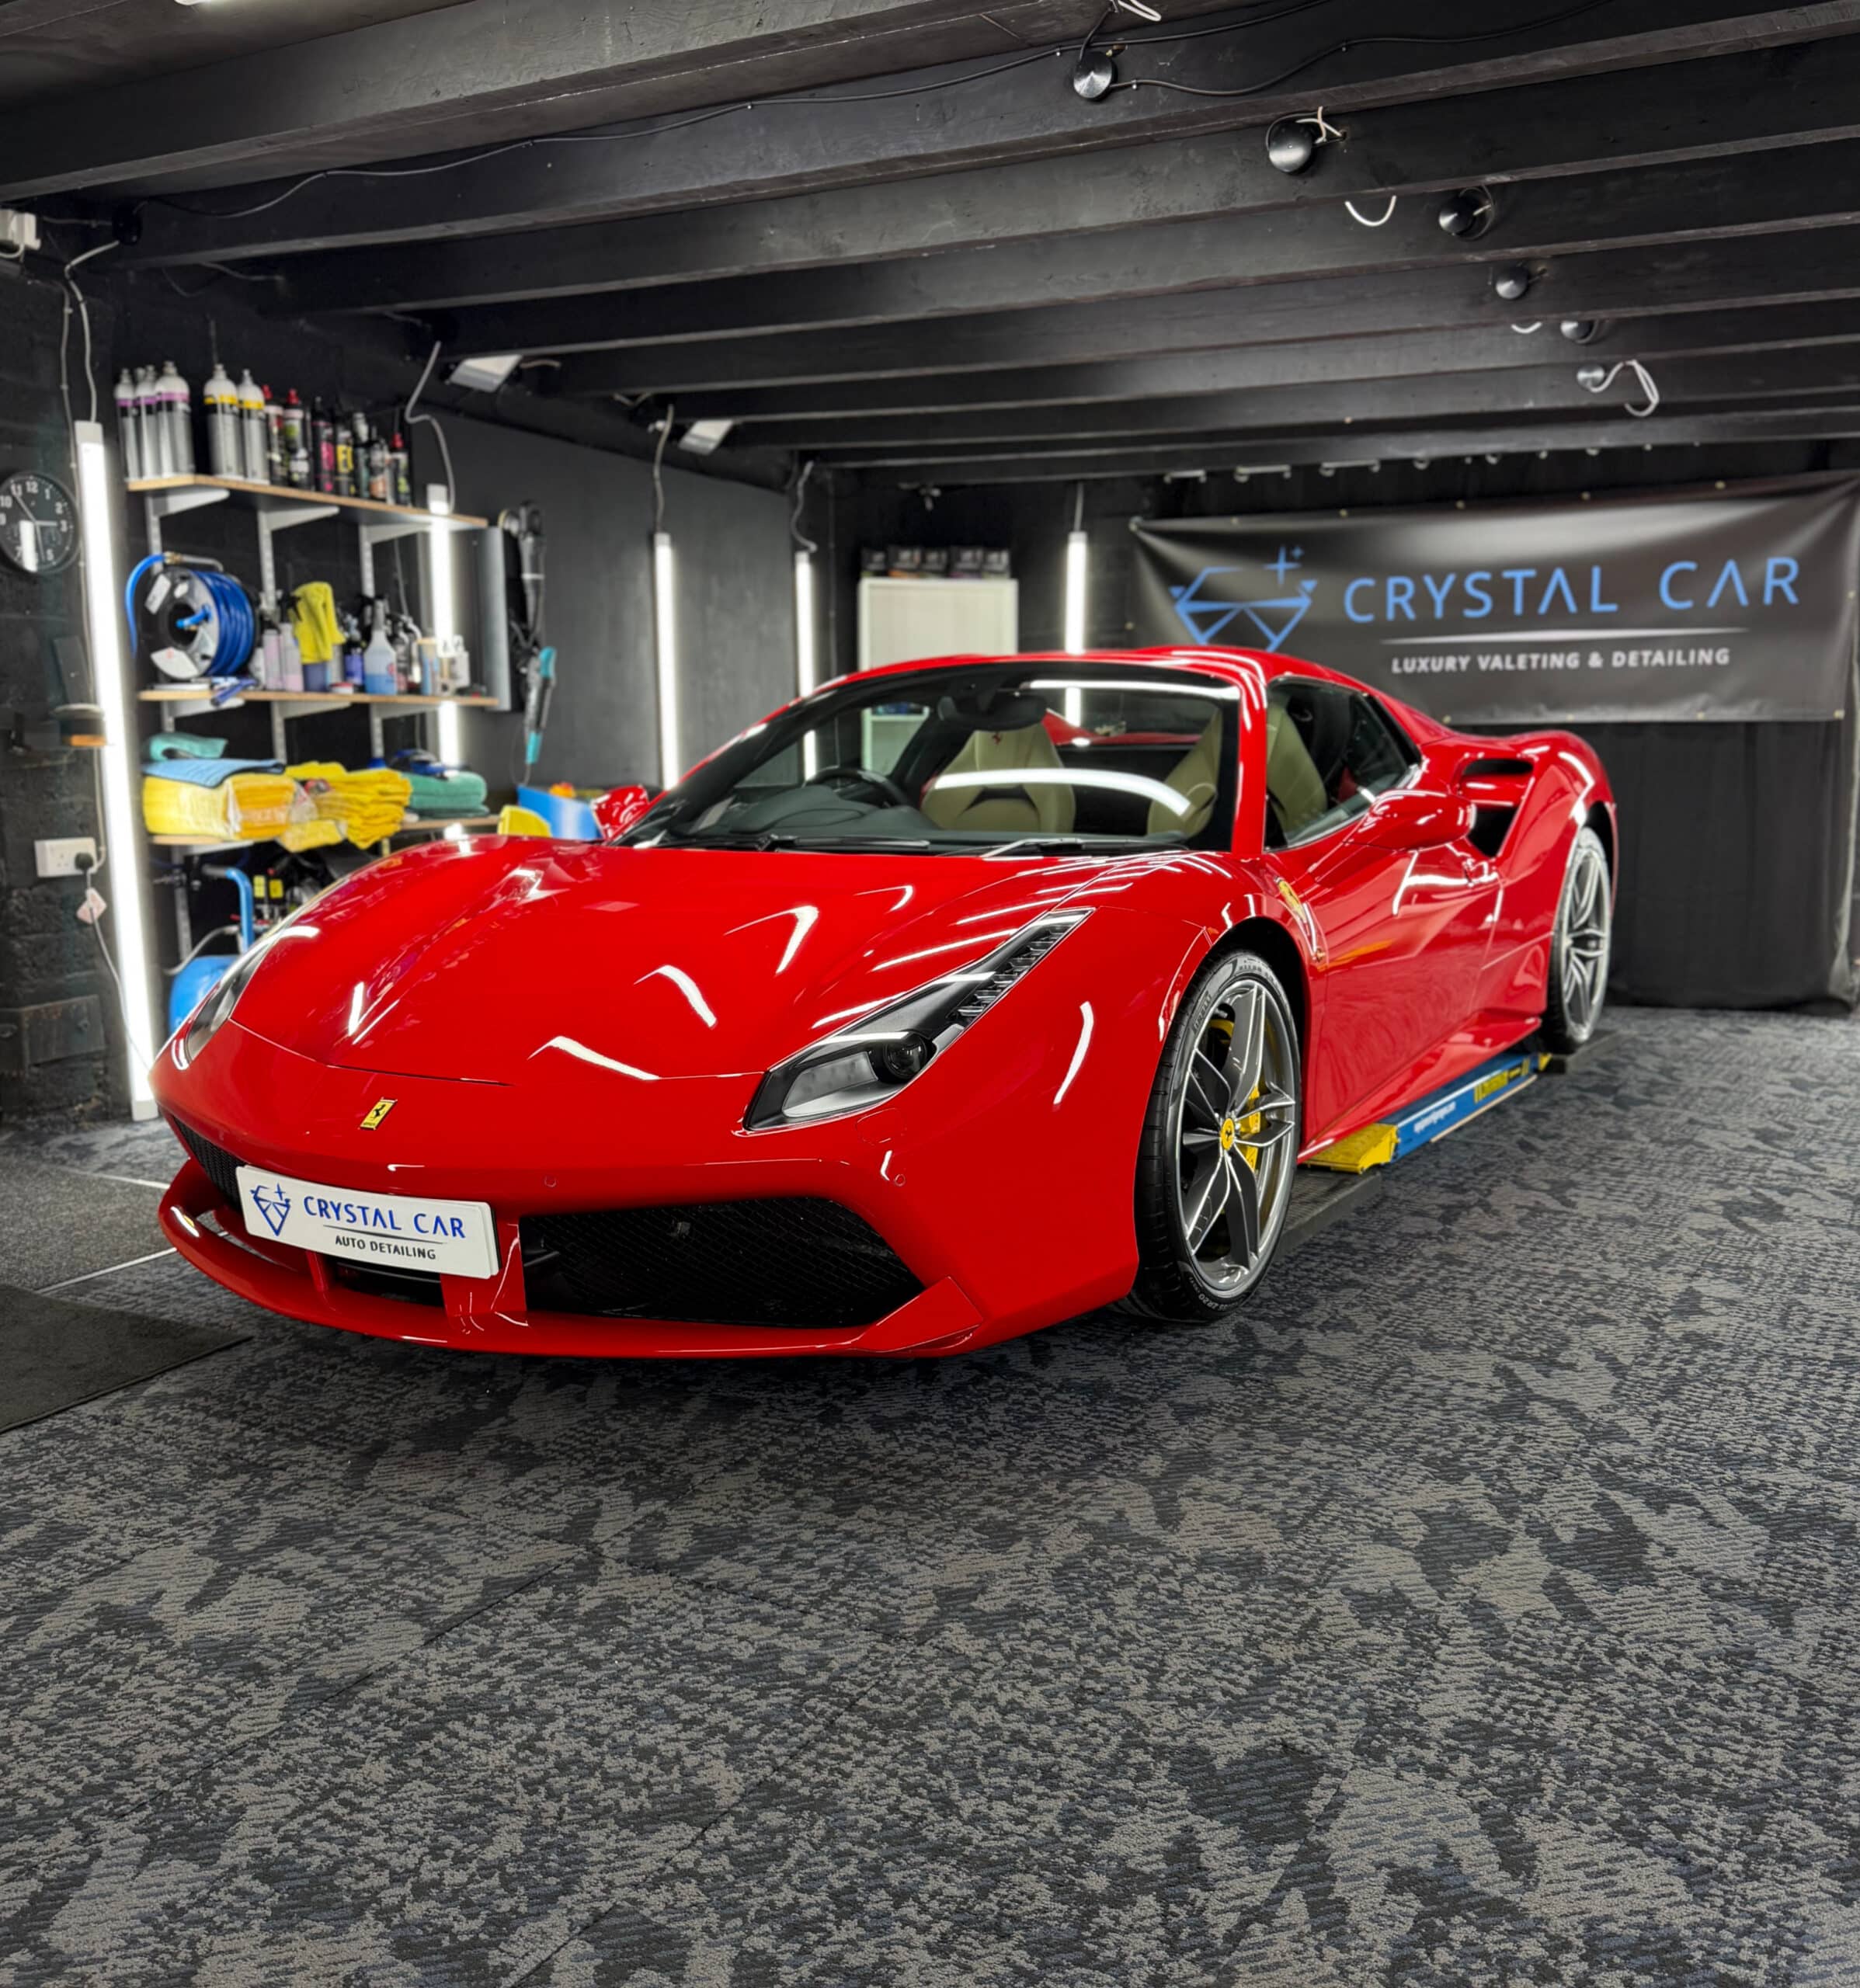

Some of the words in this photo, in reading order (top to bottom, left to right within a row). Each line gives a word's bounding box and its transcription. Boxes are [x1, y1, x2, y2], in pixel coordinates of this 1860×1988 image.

[26, 481, 38, 493] 12
[44, 488, 50, 499] 1
[0, 495, 12, 508] 10
[55, 502, 63, 514] 2
[60, 520, 68, 532] 3
[47, 548, 54, 561] 5
[1344, 565, 1619, 624] CRYSTAL
[1659, 557, 1799, 610] CAR
[1392, 655, 1471, 674] LUXURY
[1477, 651, 1580, 670] VALETING
[1587, 651, 1604, 668] &
[1611, 648, 1730, 669] DETAILING
[304, 1196, 402, 1232] CRYSTAL
[413, 1213, 466, 1239] CAR
[335, 1235, 367, 1250] AUTO
[370, 1241, 436, 1260] DETAILING
